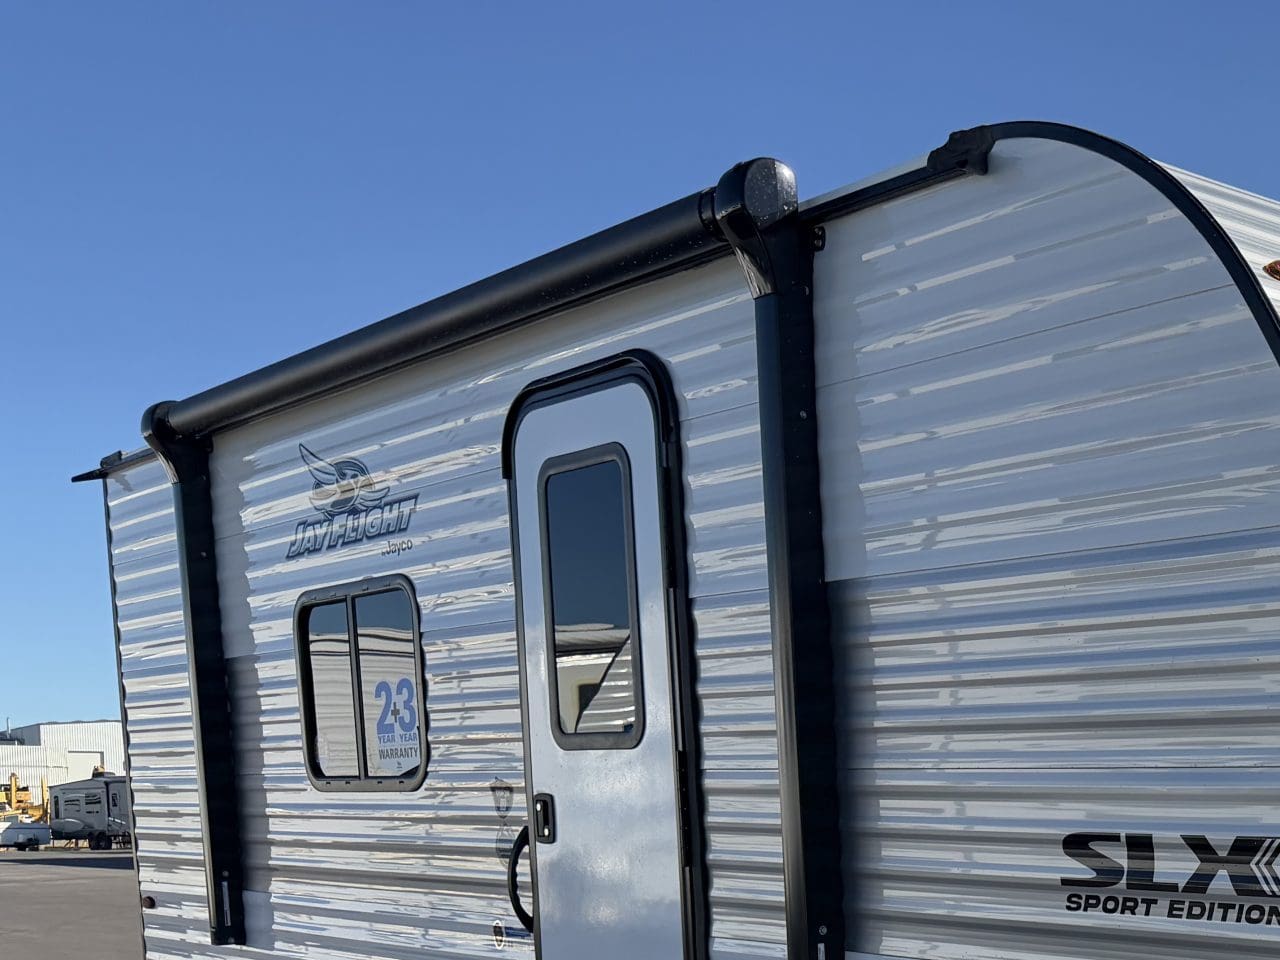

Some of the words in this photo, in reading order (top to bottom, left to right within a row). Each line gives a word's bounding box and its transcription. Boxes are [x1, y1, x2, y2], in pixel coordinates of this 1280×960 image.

[286, 518, 331, 560] JAY
[326, 493, 420, 549] FLIGHT
[386, 539, 413, 557] Jayco
[378, 734, 396, 745] YEAR
[399, 732, 418, 742] YEAR
[379, 747, 418, 760] WARRANTY
[1065, 893, 1159, 917] SPORT
